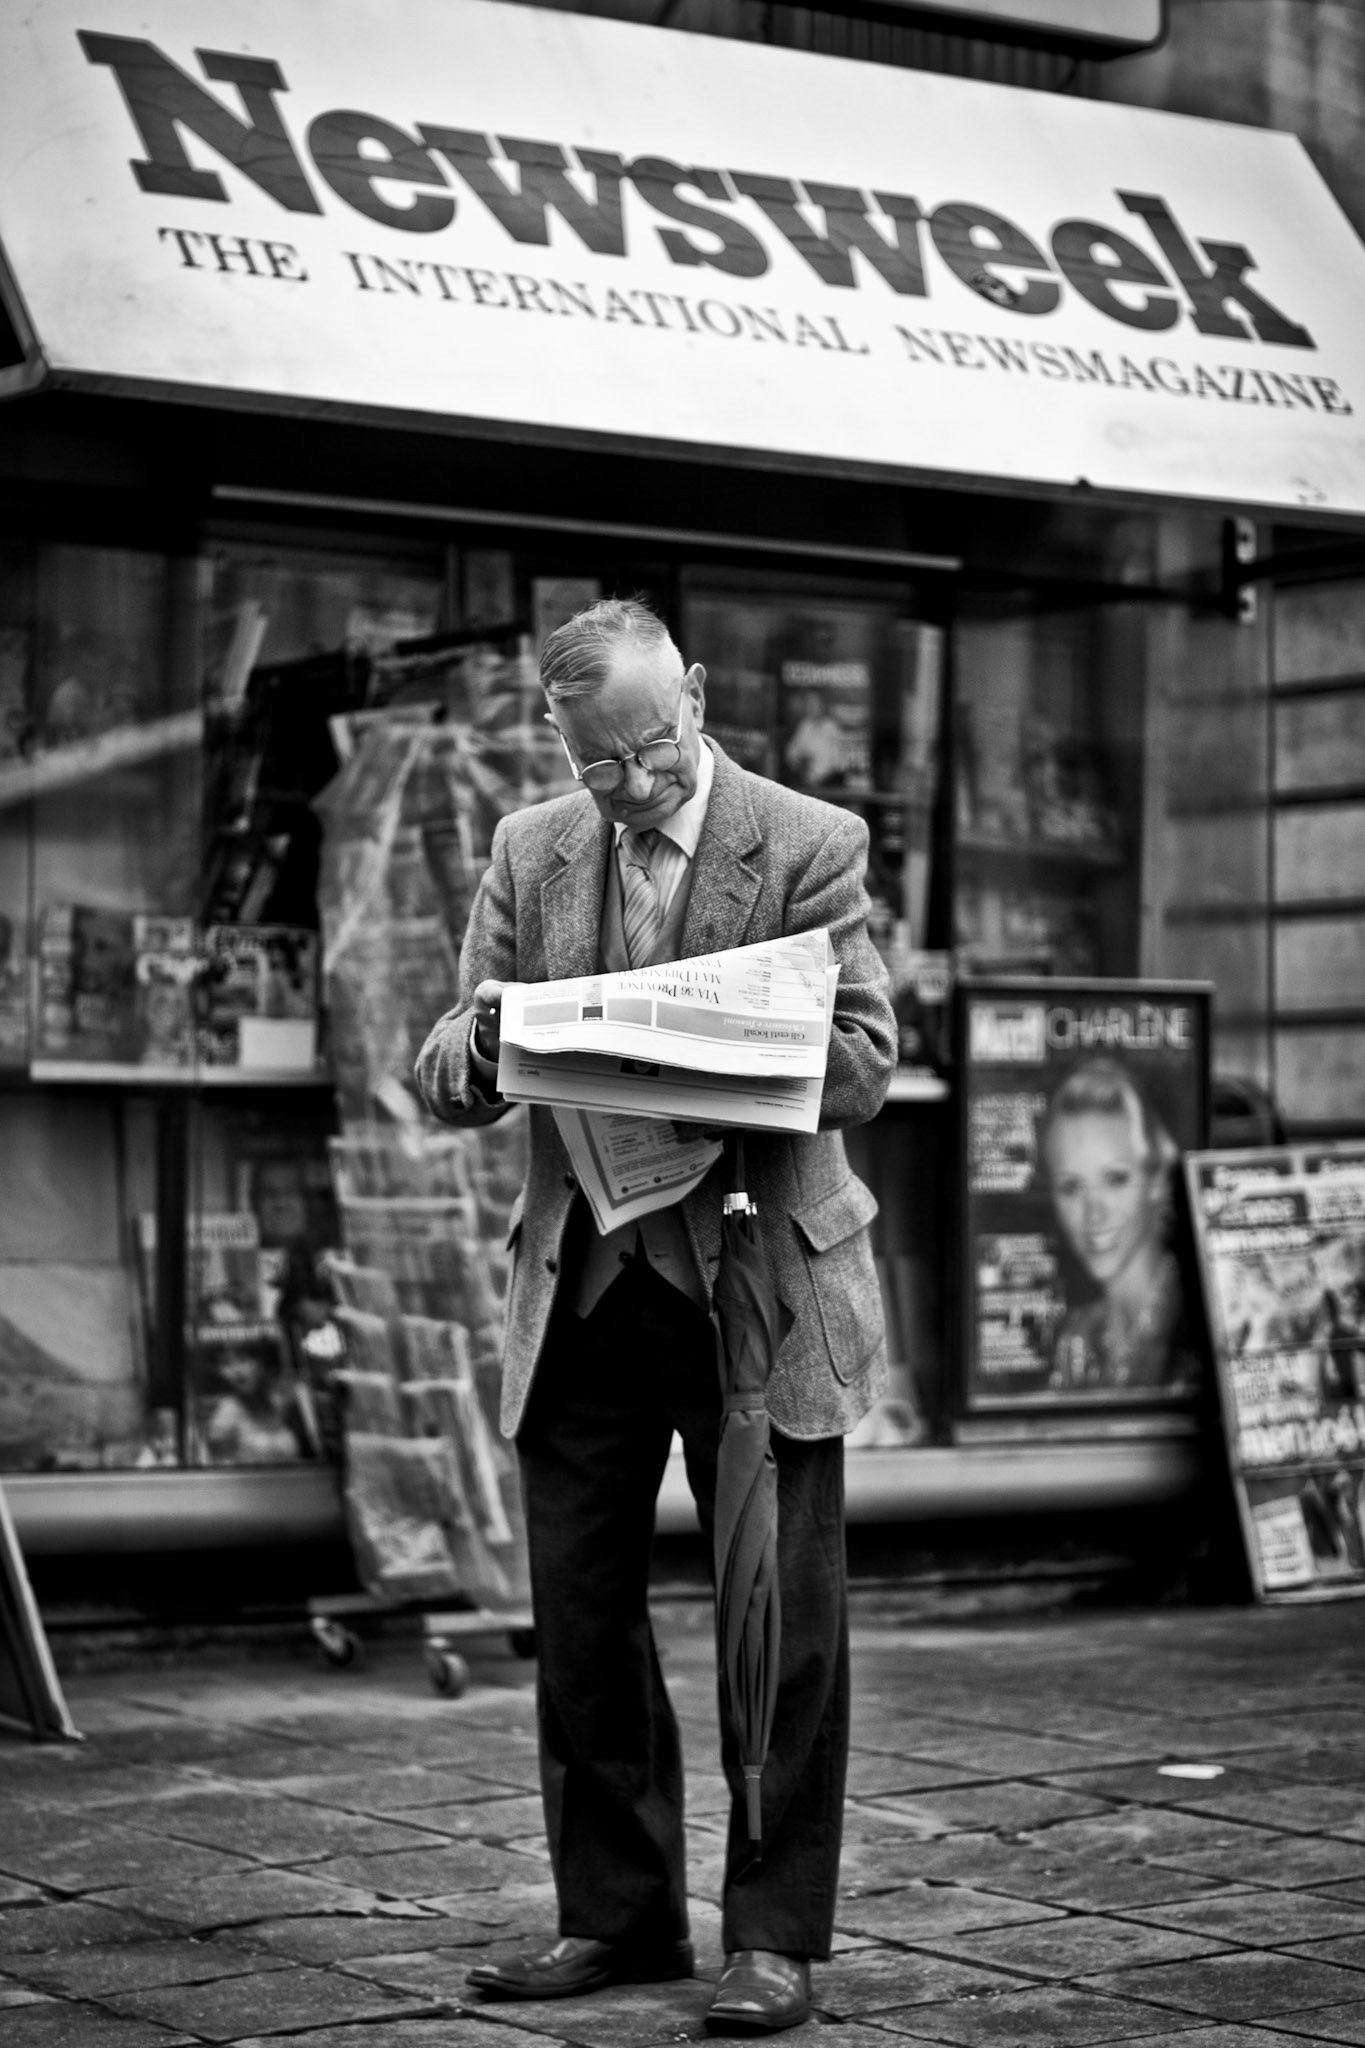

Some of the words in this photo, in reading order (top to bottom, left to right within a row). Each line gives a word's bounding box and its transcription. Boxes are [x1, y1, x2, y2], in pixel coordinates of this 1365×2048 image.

[77, 29, 1317, 350] Newsweek
[158, 228, 308, 283] THE
[343, 251, 871, 355] INTERNATIONAL
[895, 326, 1354, 415] NEWSMAGAZINE
[743, 1028, 768, 1039] locali
